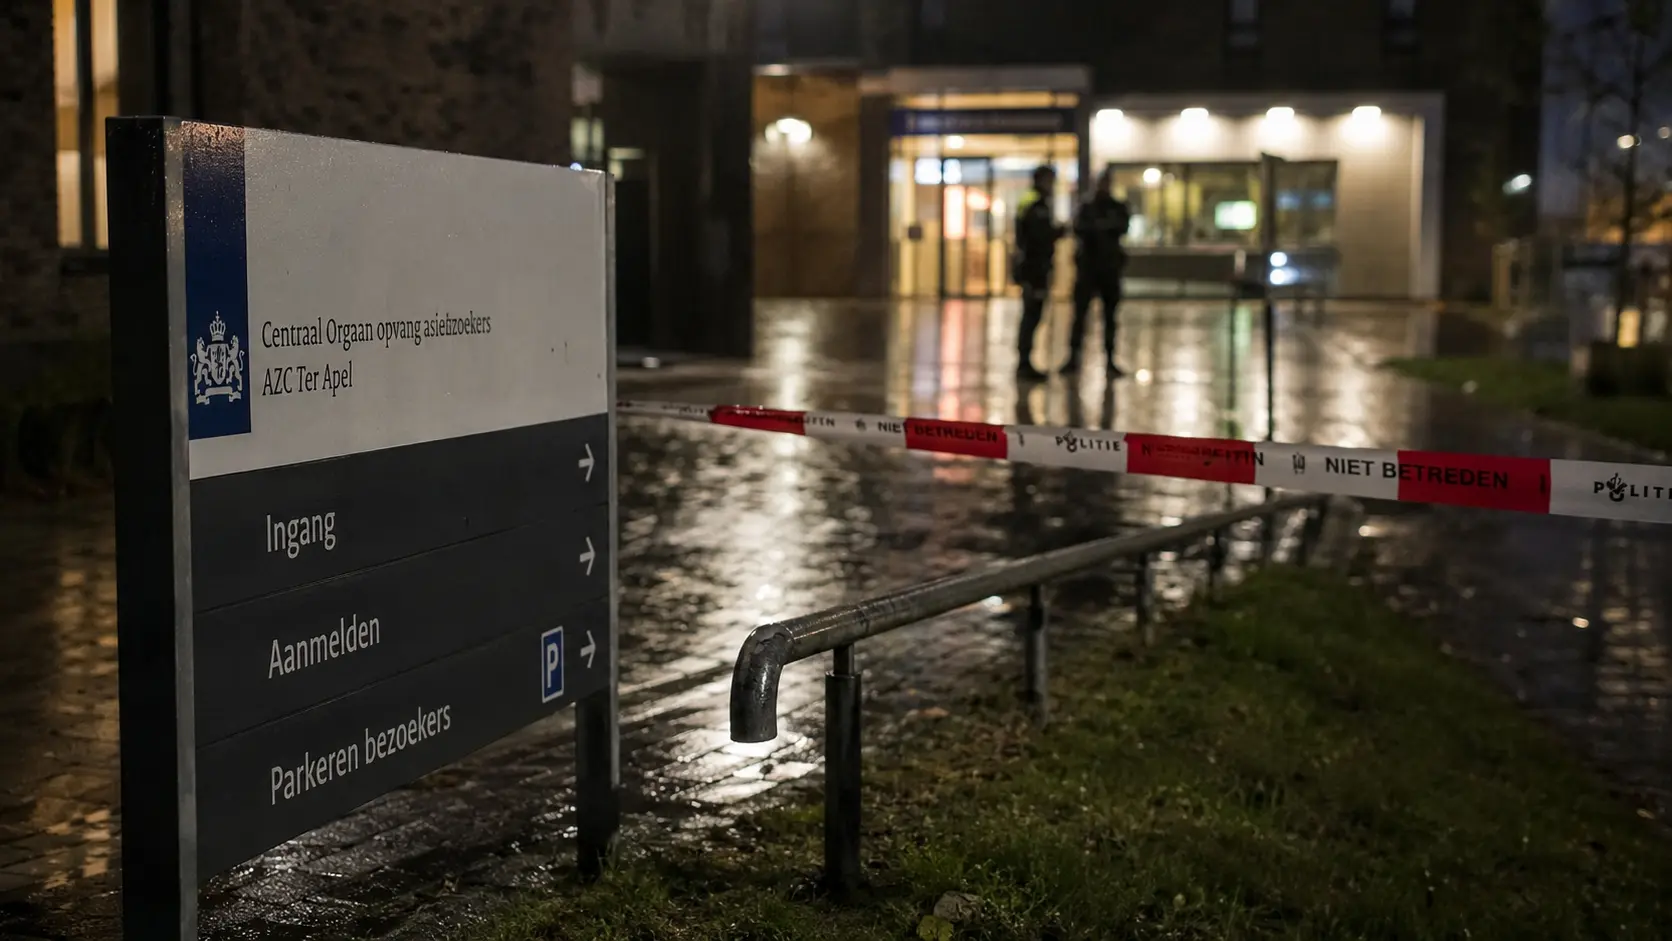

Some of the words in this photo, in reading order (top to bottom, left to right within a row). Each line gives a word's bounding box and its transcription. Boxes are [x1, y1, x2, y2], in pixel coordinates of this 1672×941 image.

[262, 317, 323, 349] Centraal
[326, 318, 374, 352] Orgaan
[376, 318, 422, 349] opvang
[262, 366, 293, 396] AZC
[297, 365, 320, 393] Ter
[322, 360, 354, 398] Apel
[1325, 456, 1375, 478] NIET
[1382, 462, 1509, 490] BETREDEN
[266, 511, 337, 560] Ingang
[268, 613, 381, 680] Aanmelden
[546, 642, 560, 689] P
[271, 742, 359, 806] Parkeren
[364, 703, 452, 765] bezoekers
